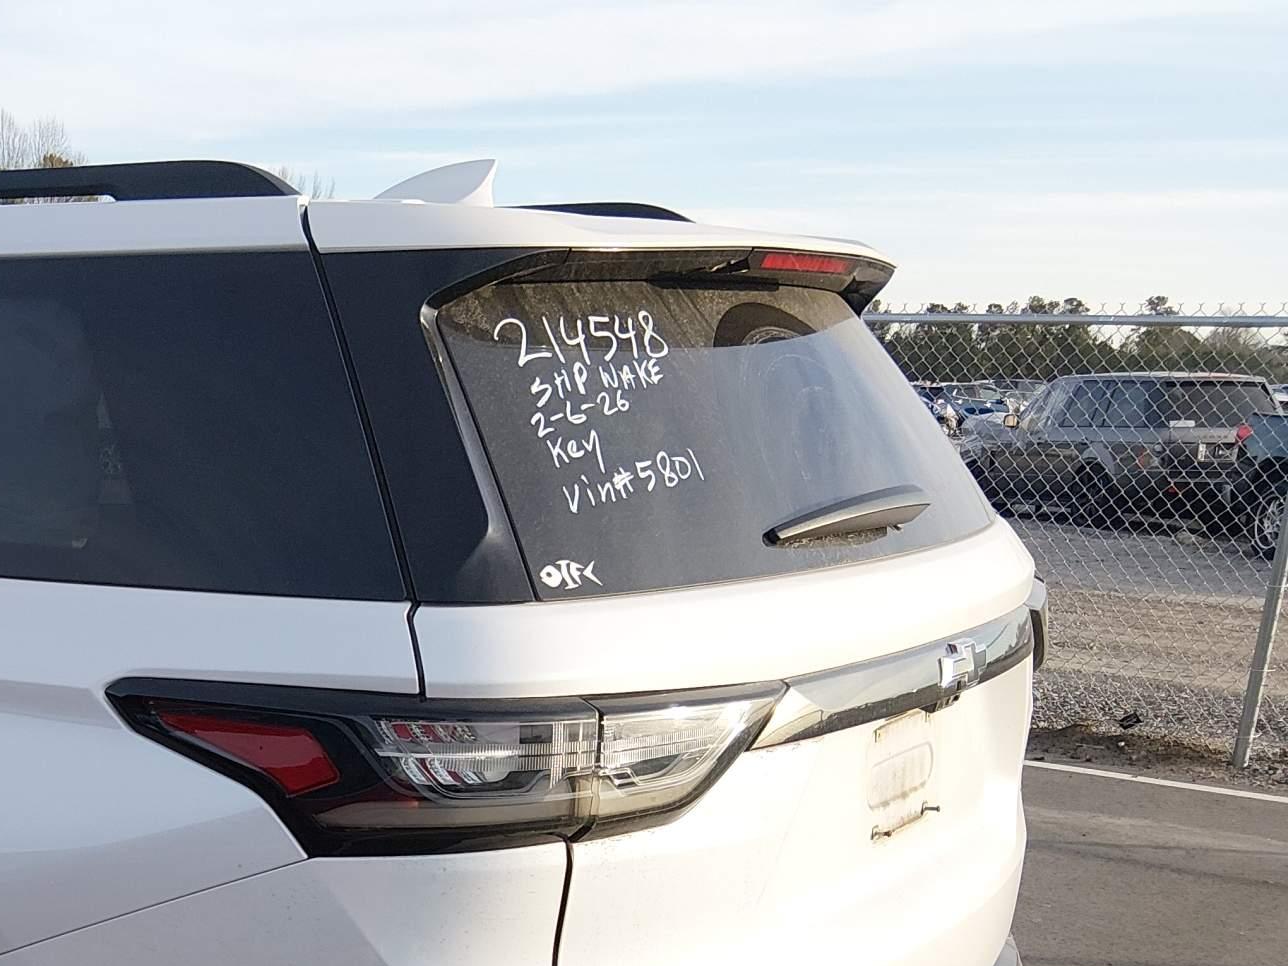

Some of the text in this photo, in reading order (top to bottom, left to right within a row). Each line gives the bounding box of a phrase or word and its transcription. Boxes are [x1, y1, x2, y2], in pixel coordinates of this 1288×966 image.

[493, 310, 669, 368] 214548
[530, 390, 630, 438] 2-6-26
[546, 429, 606, 474] Key
